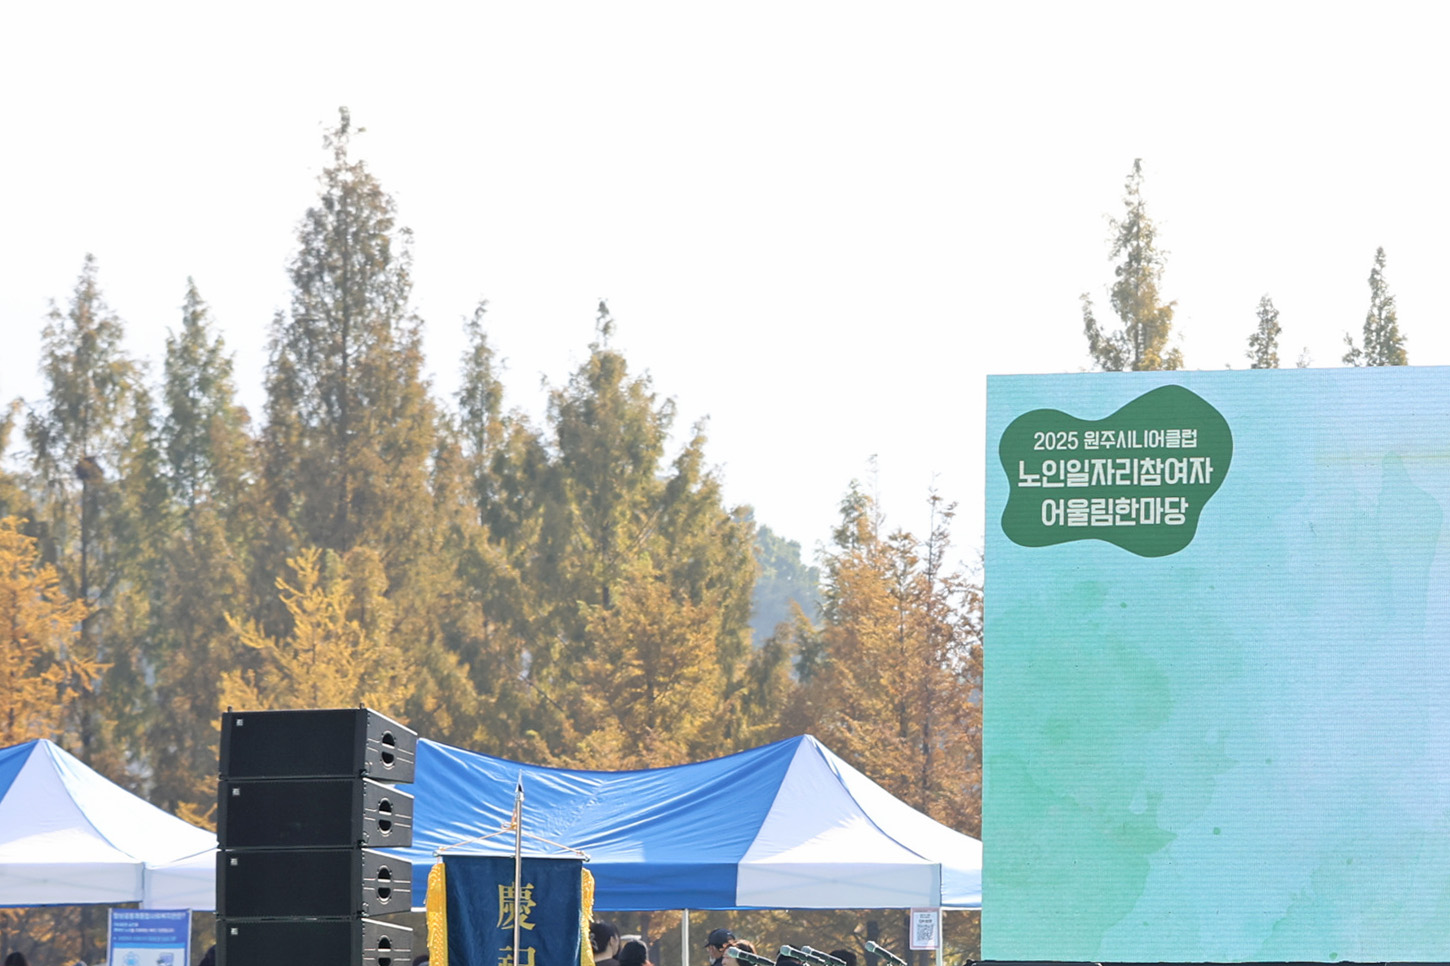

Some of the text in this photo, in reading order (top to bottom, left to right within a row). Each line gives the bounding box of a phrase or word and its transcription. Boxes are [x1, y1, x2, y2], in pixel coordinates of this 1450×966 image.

[1033, 429, 1198, 451] 2025 원주시니어클럽
[1018, 457, 1214, 488] 노인일자리참여자
[1041, 497, 1189, 527] 어울림한마당
